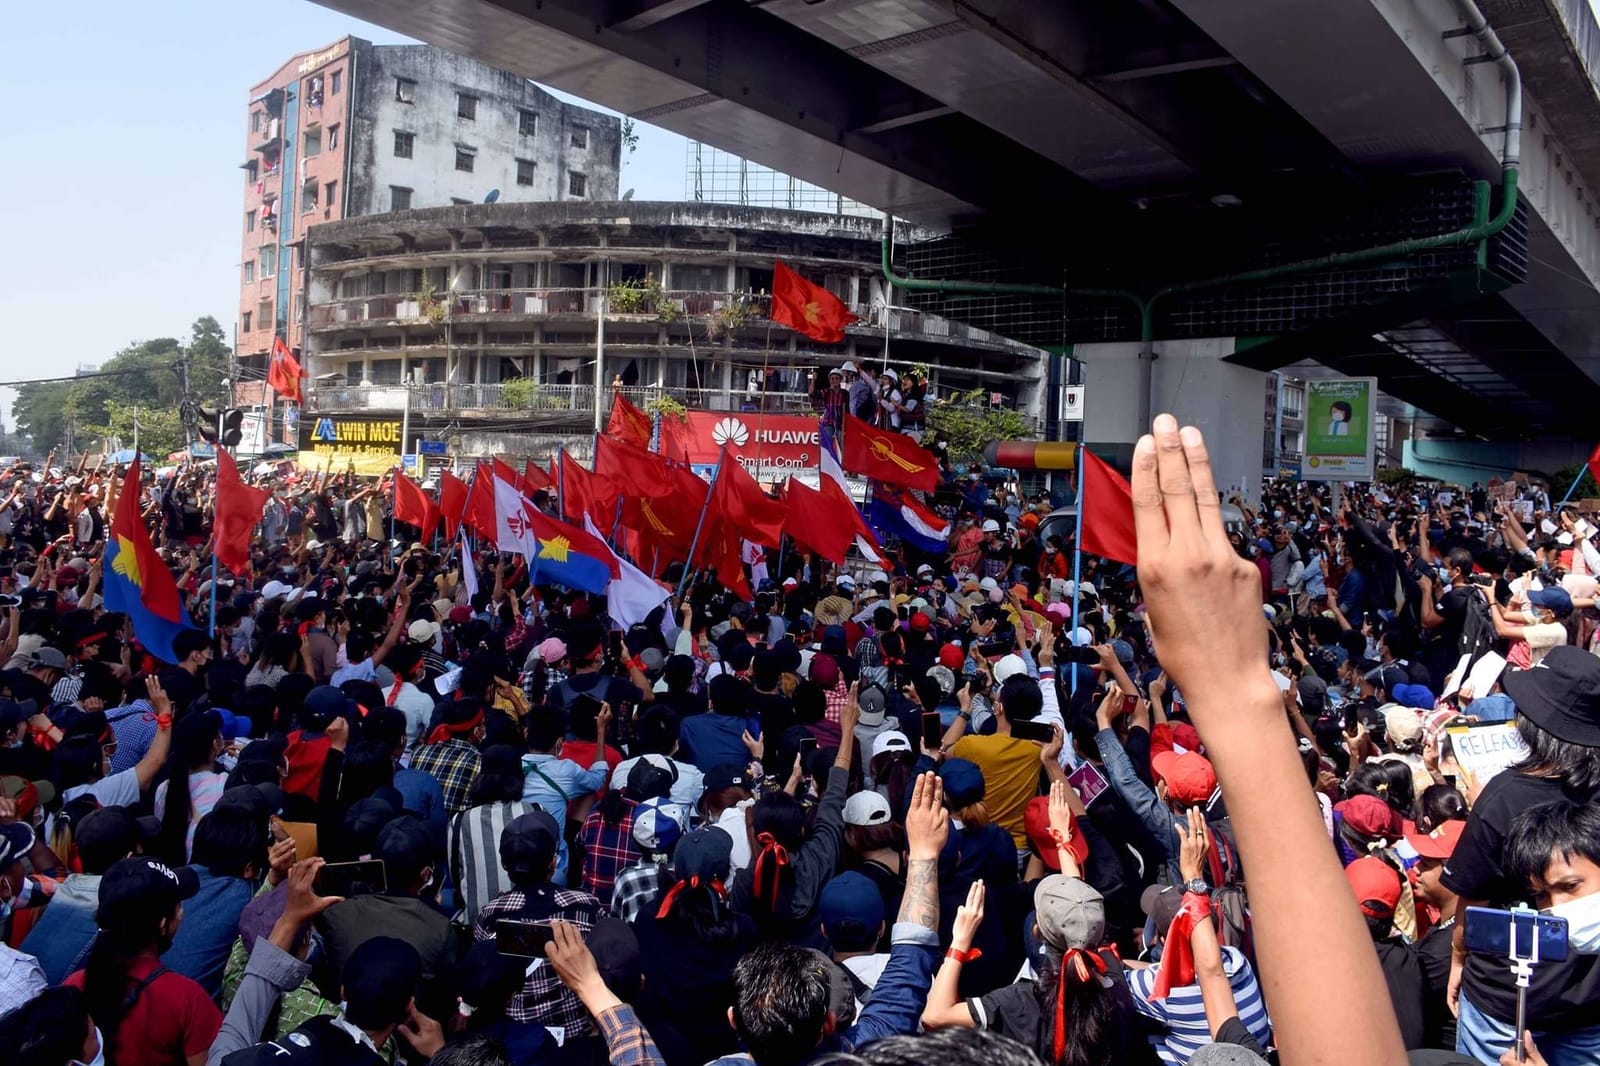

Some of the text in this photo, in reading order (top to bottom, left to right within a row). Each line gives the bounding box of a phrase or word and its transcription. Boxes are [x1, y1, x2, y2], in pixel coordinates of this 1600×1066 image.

[336, 422, 366, 440] LWIN
[369, 422, 401, 441] MOE
[755, 430, 819, 444] HUAWE
[735, 454, 772, 467] Smart
[1460, 731, 1519, 757] RELEAS
